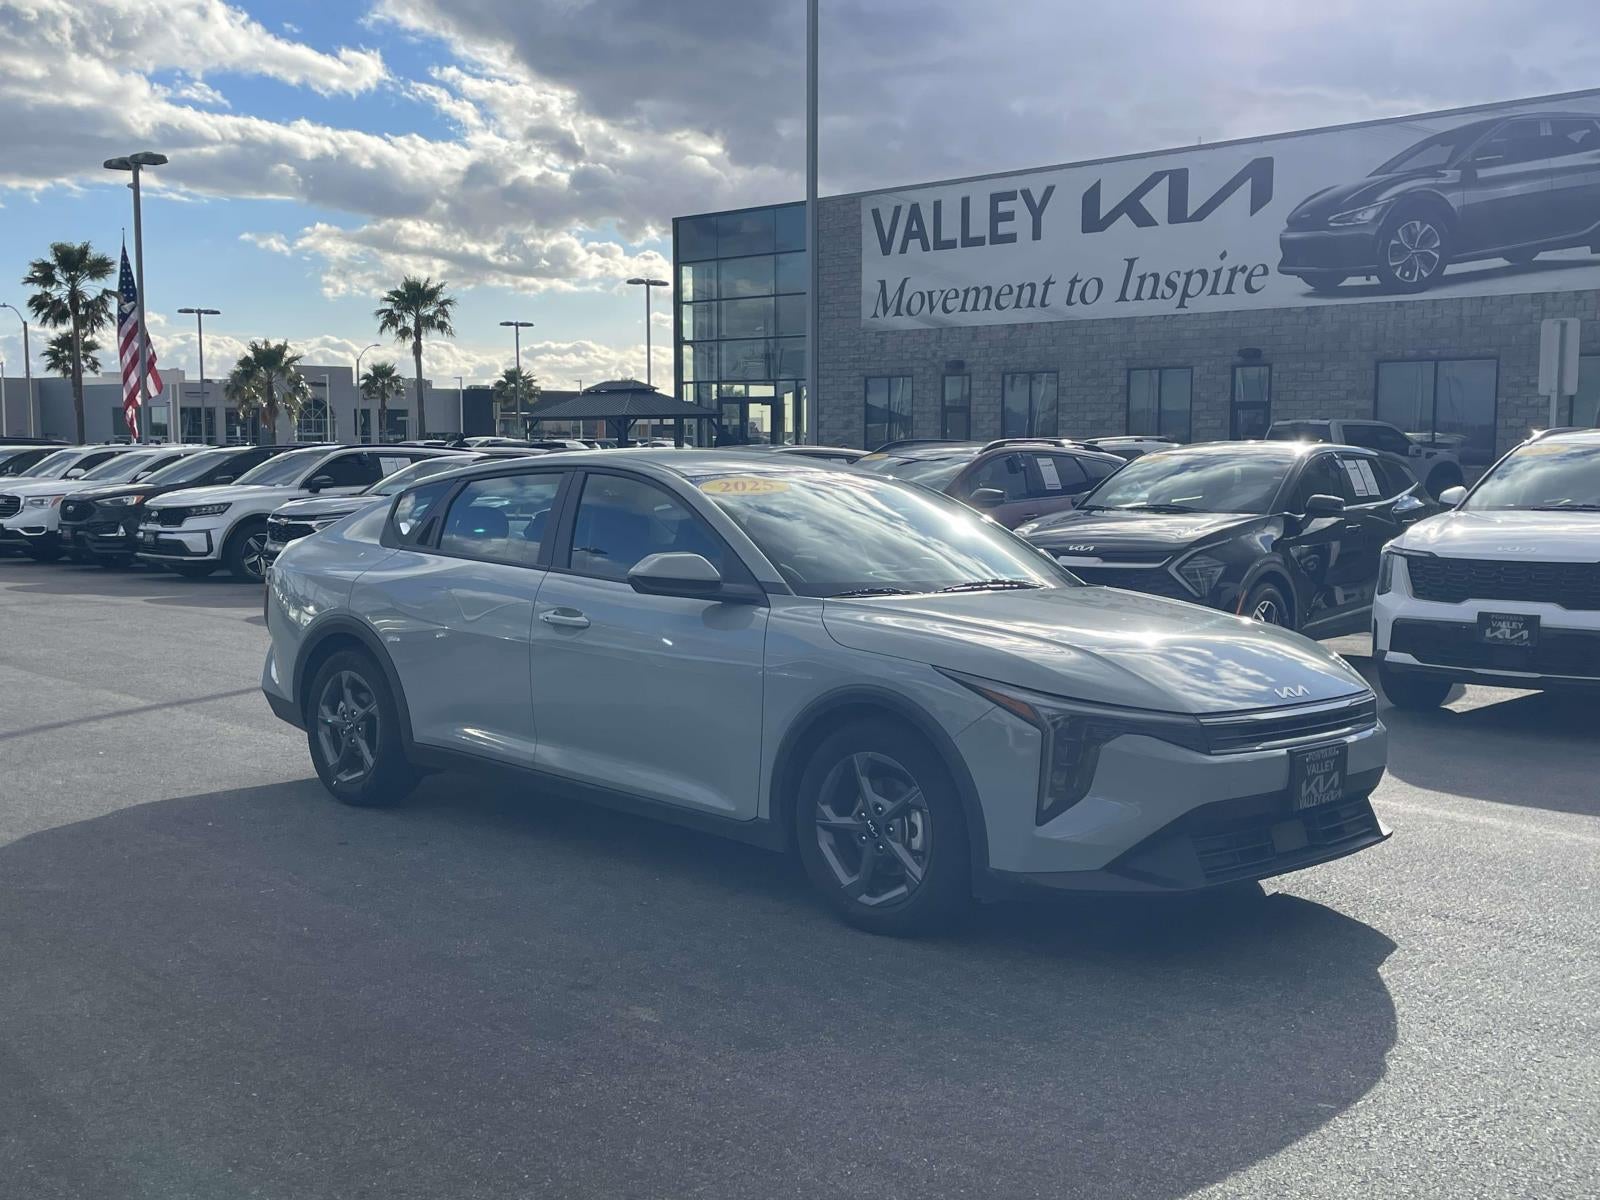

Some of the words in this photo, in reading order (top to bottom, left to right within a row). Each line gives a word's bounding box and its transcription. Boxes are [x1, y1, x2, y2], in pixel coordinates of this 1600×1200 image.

[871, 184, 1056, 257] VALLEY
[1081, 156, 1275, 234] KIA
[871, 273, 1056, 320] Movement
[1065, 271, 1104, 307] to
[1114, 250, 1270, 309] Inspire
[719, 480, 775, 493] 2025
[1491, 621, 1524, 629] VALLEY
[1306, 759, 1335, 776] VALLEY
